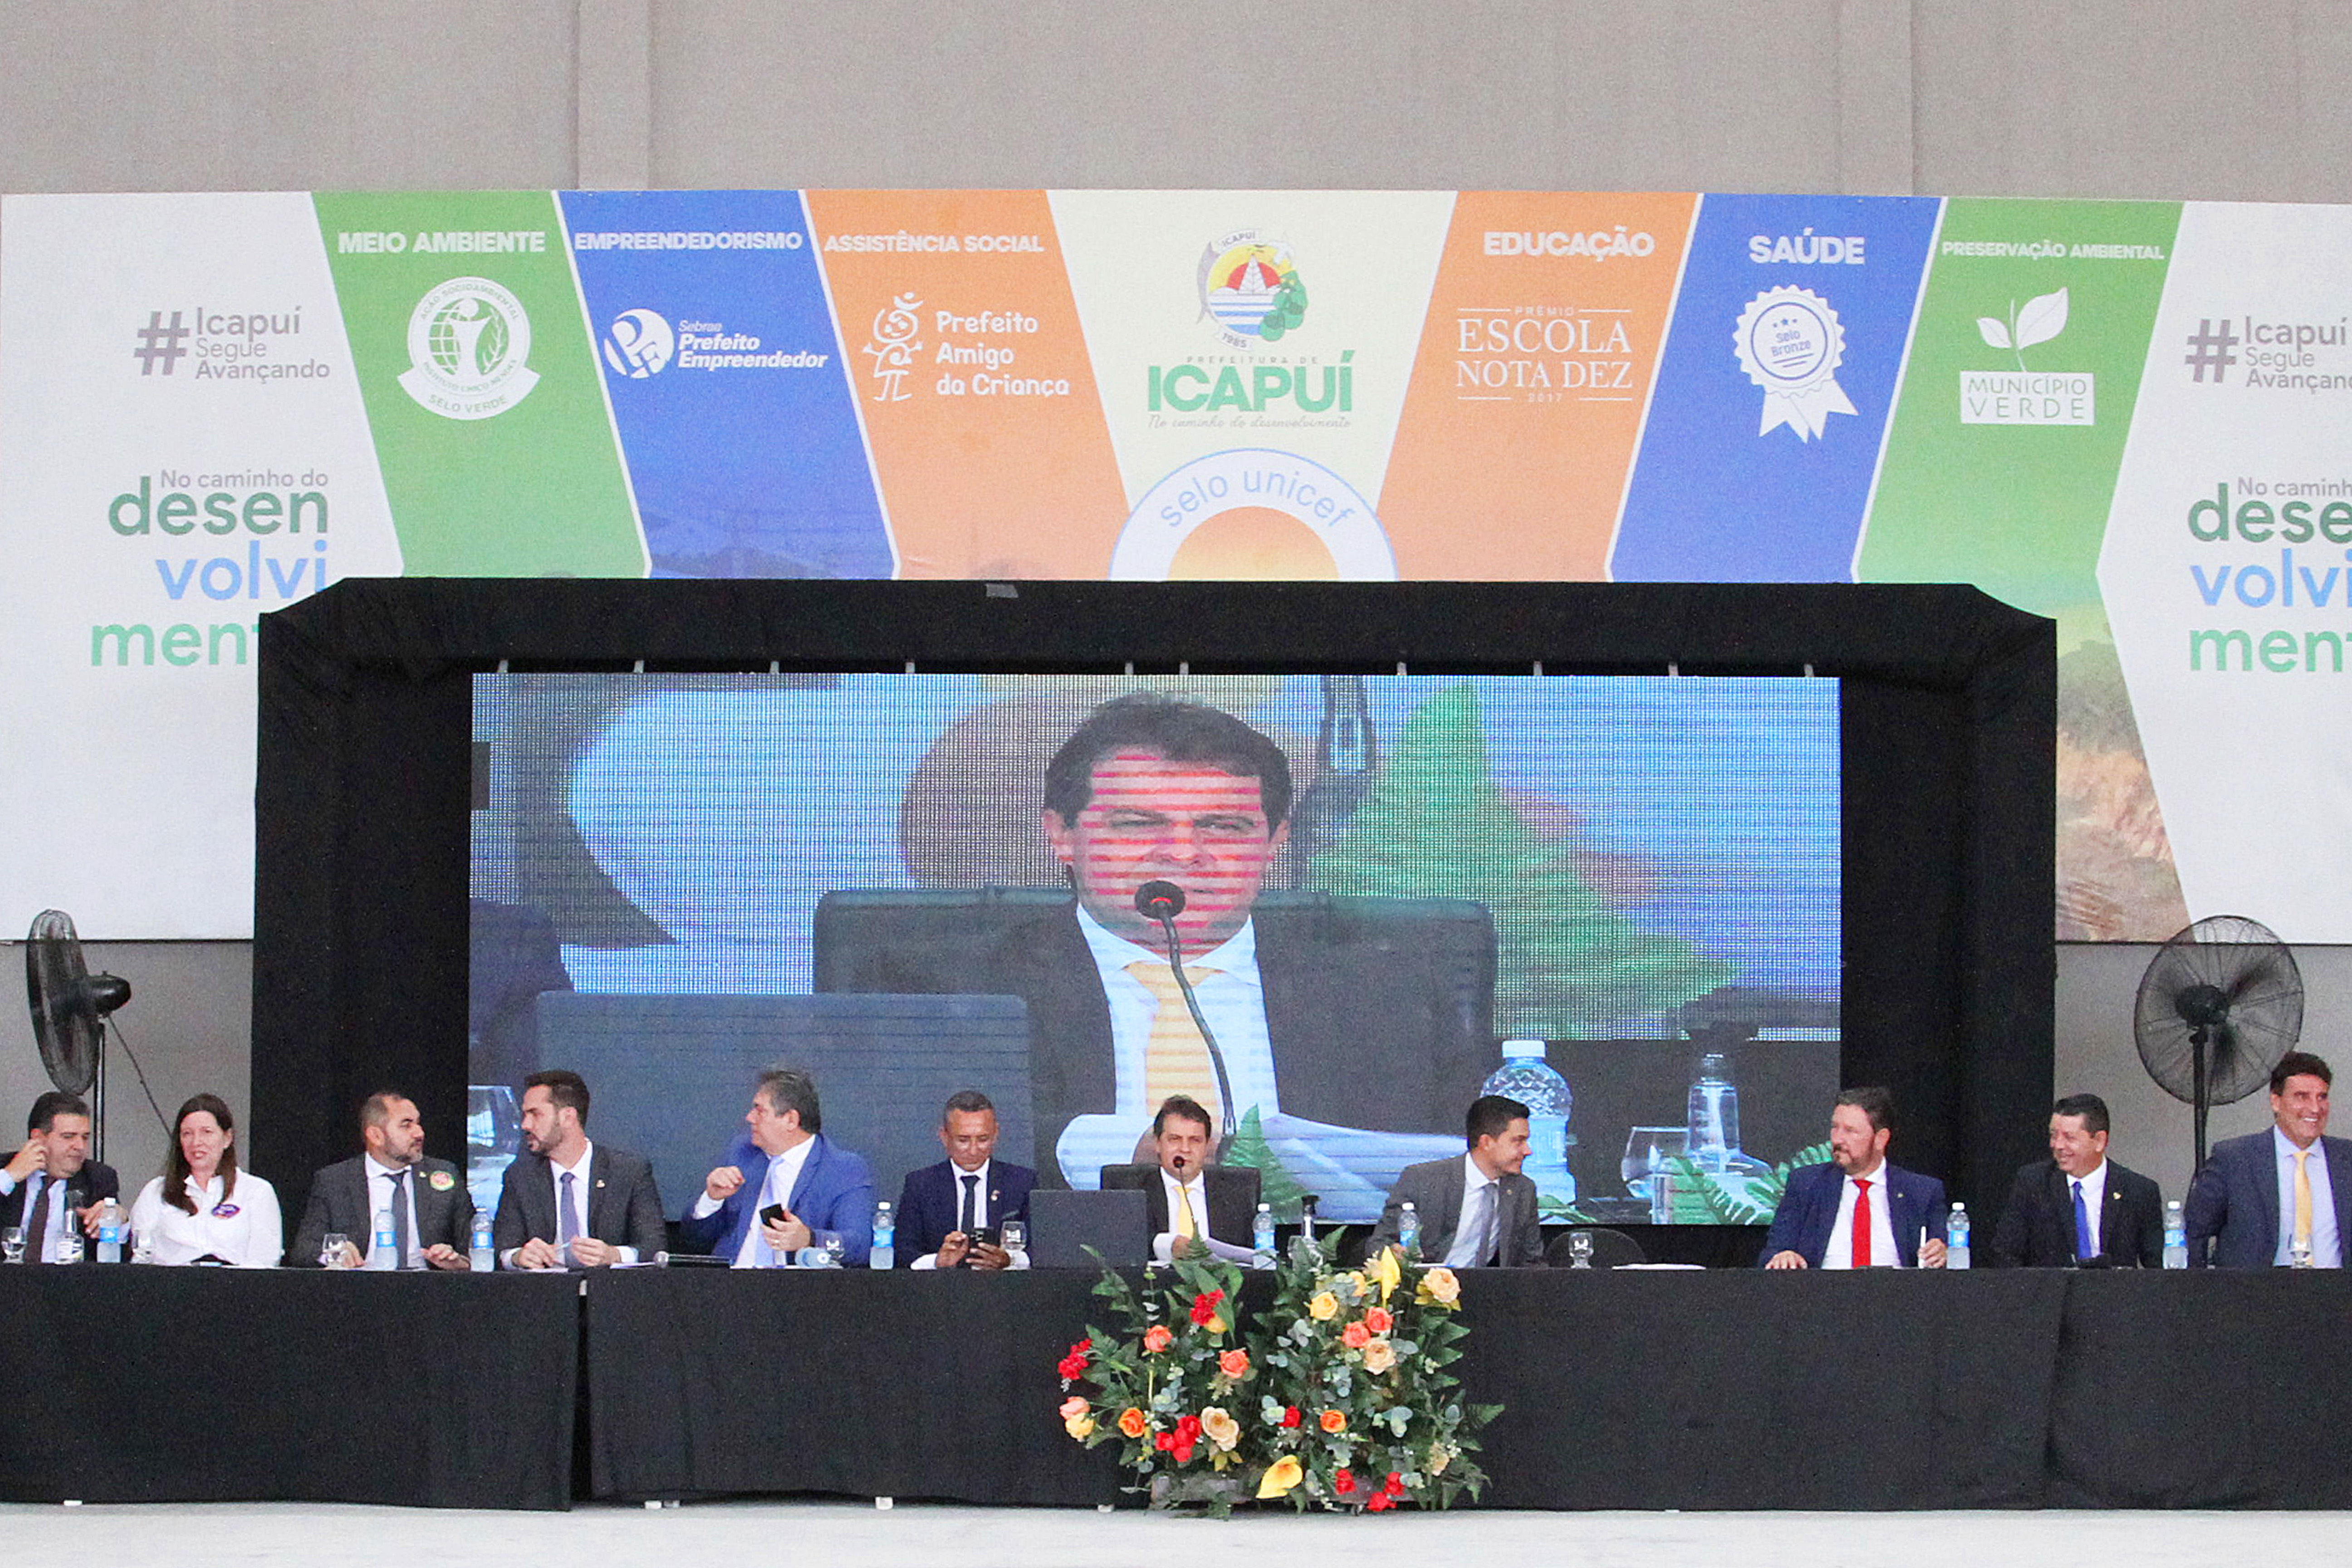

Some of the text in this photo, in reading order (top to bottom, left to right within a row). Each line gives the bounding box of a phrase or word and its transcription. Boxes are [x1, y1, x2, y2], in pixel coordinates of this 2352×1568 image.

[338, 231, 545, 253] MEIO AMBIENTE
[574, 232, 803, 250] EMPREENDEDORISMO
[824, 230, 1045, 252] ASSISTÊNCIA SOCIAL
[1484, 225, 1655, 262] EDUCAÇÃO
[1749, 227, 1865, 265] SAÚDE
[1942, 240, 2165, 260] PRESERVAÇÃO AMBIENTAL
[196, 305, 302, 342] Icapuí
[936, 310, 1039, 333] Prefeito
[2245, 316, 2347, 352] Icapuí
[678, 333, 761, 350] Prefeito
[1222, 333, 1247, 348] 1985
[1457, 318, 1632, 353] ESCOLA
[196, 338, 266, 362] Segue
[678, 350, 828, 372] Empreendedor
[936, 342, 1015, 371] Amigo
[2245, 347, 2315, 372] Segue
[195, 358, 330, 384] Avançando
[1148, 350, 1355, 413] ICAPUÍ
[1455, 360, 1633, 388] NOTA DEZ
[936, 372, 1070, 397] da Criança
[1528, 392, 1563, 402] 2017
[1967, 375, 2087, 396] MUNICÍPIO
[429, 394, 508, 413] SELO VERDE
[1968, 397, 2085, 419] VERDE
[161, 468, 328, 488] No caminho do
[2237, 476, 2268, 496] No
[108, 475, 328, 536] desen
[1161, 470, 1356, 527] selo unicef
[155, 539, 328, 601] volvi
[91, 622, 258, 667] men
[2189, 629, 2352, 673] men
